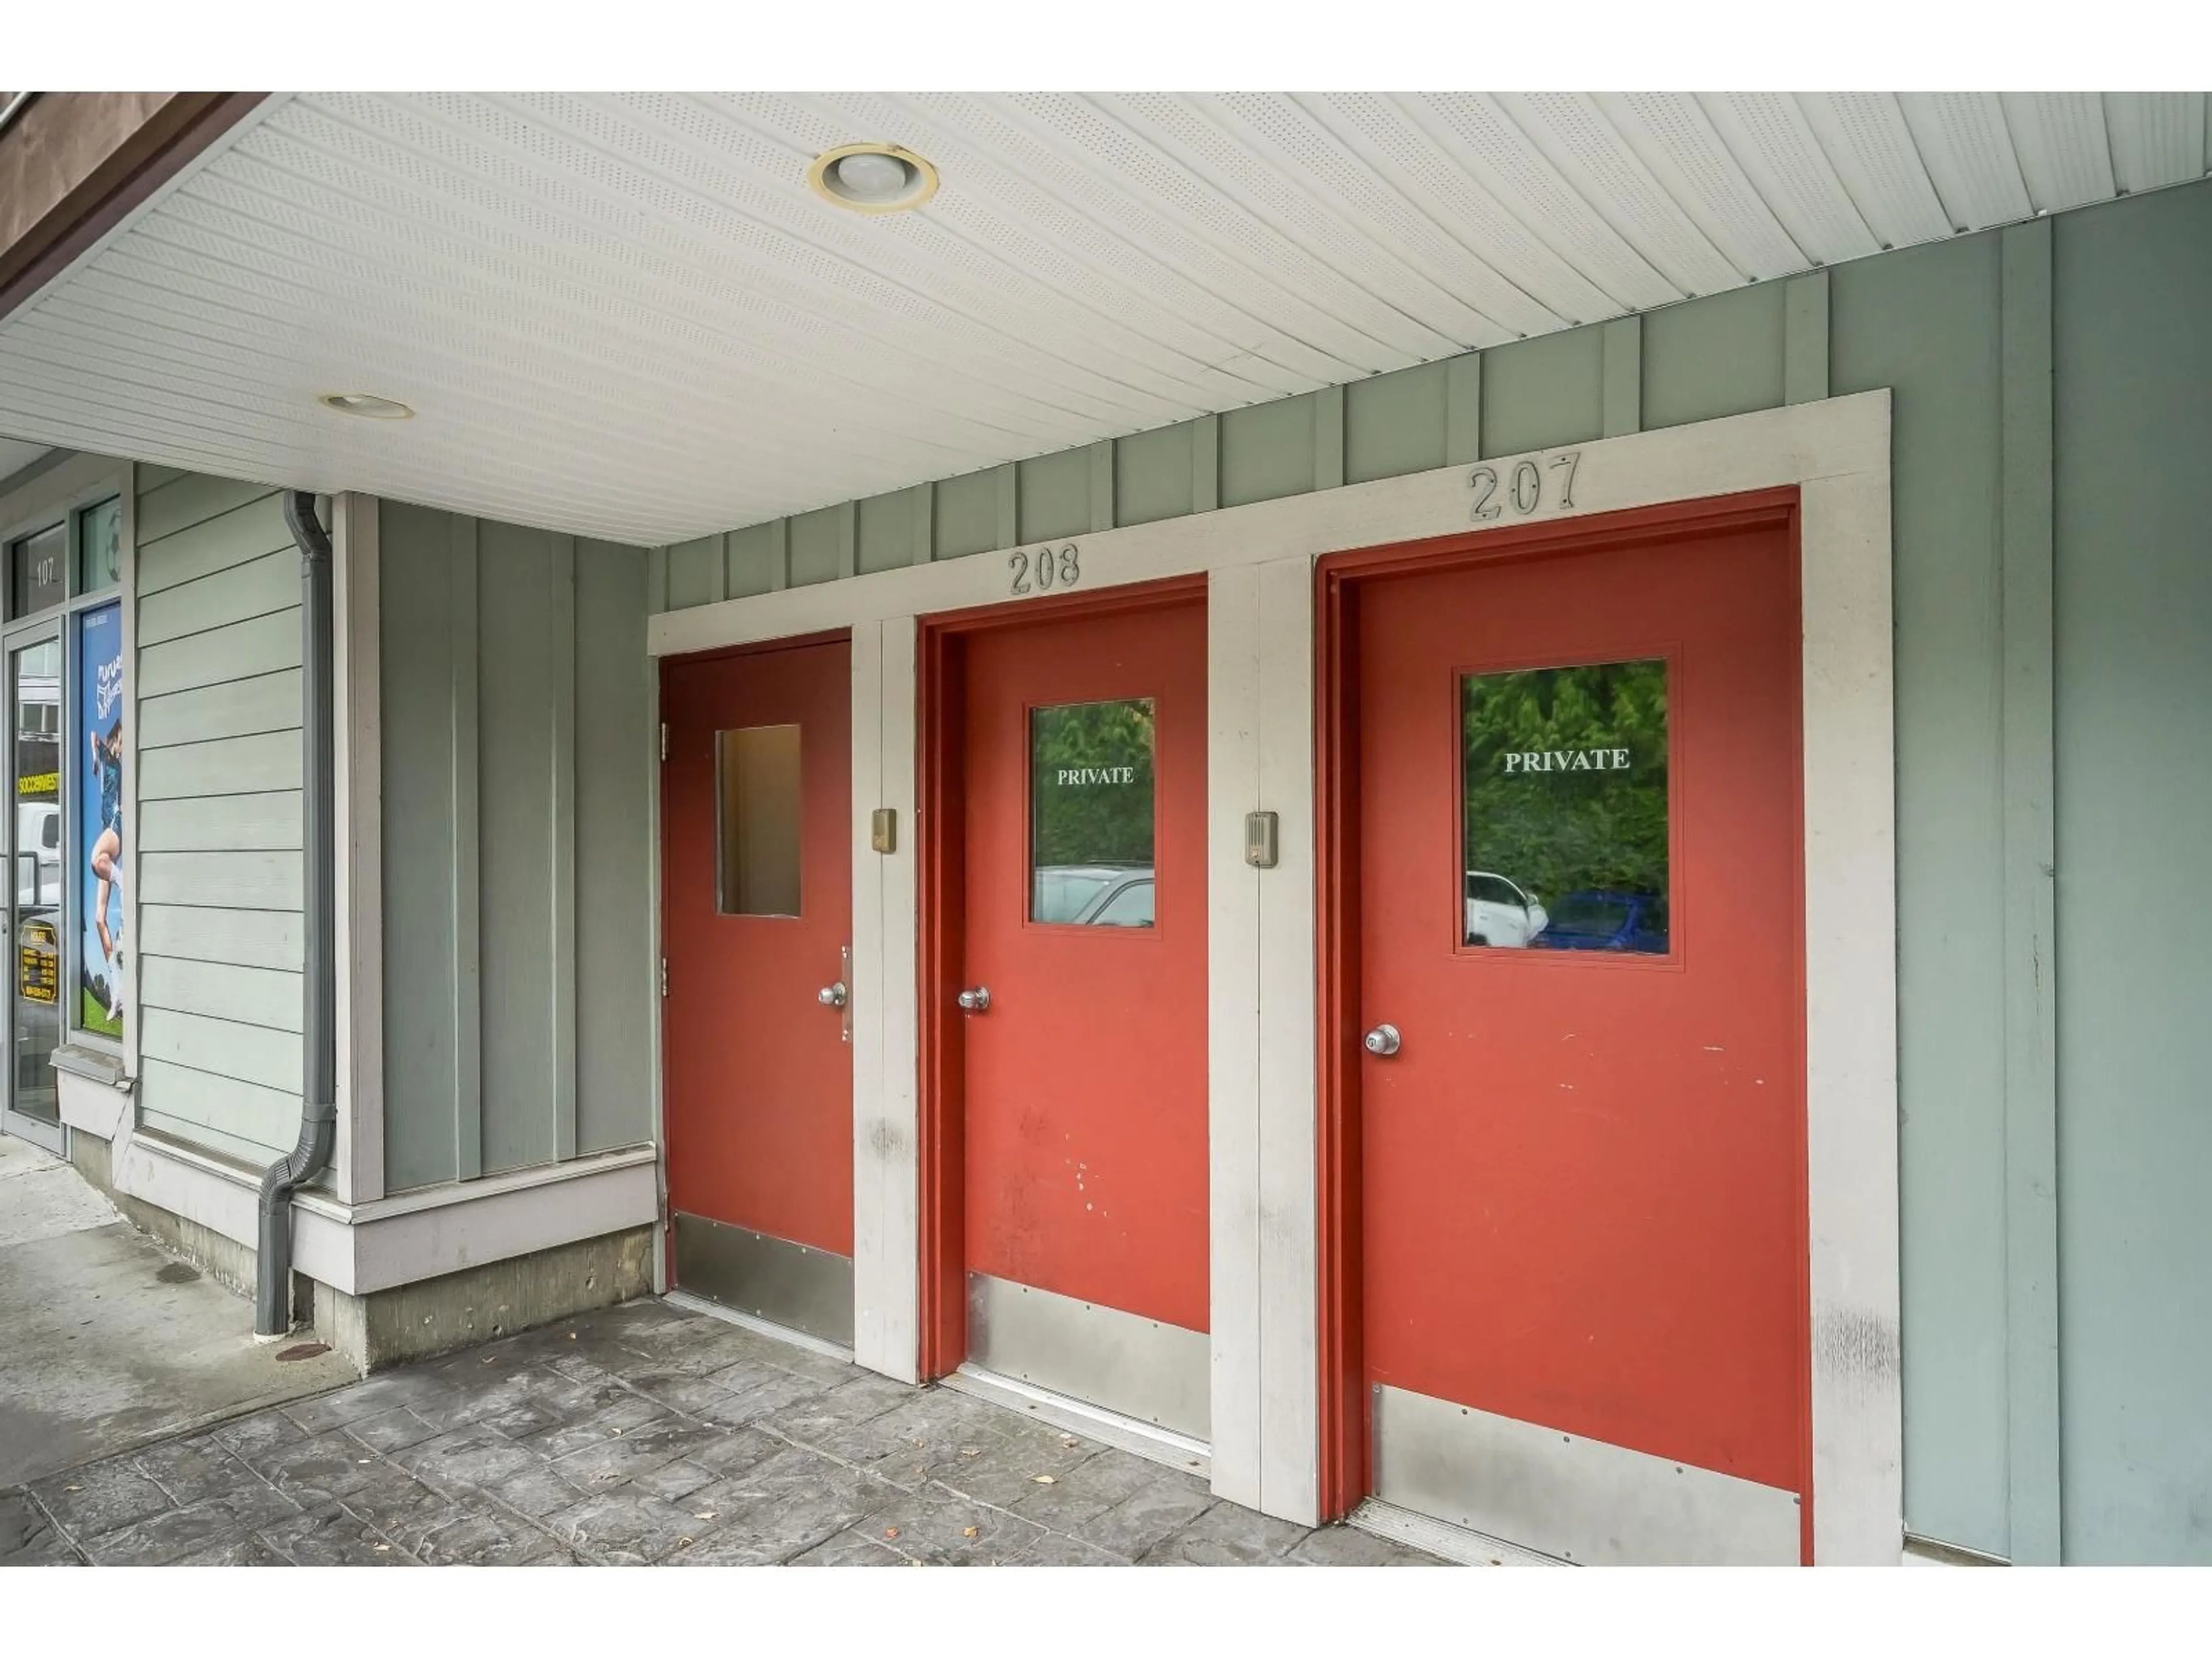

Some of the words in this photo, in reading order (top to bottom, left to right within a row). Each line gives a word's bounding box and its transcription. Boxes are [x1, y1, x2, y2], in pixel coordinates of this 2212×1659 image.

[1468, 452, 1581, 522] 207
[37, 557, 54, 587] 107
[1008, 543, 1080, 595] 208
[1503, 748, 1631, 772] PRIVATE
[1058, 767, 1134, 786] PRIVATE
